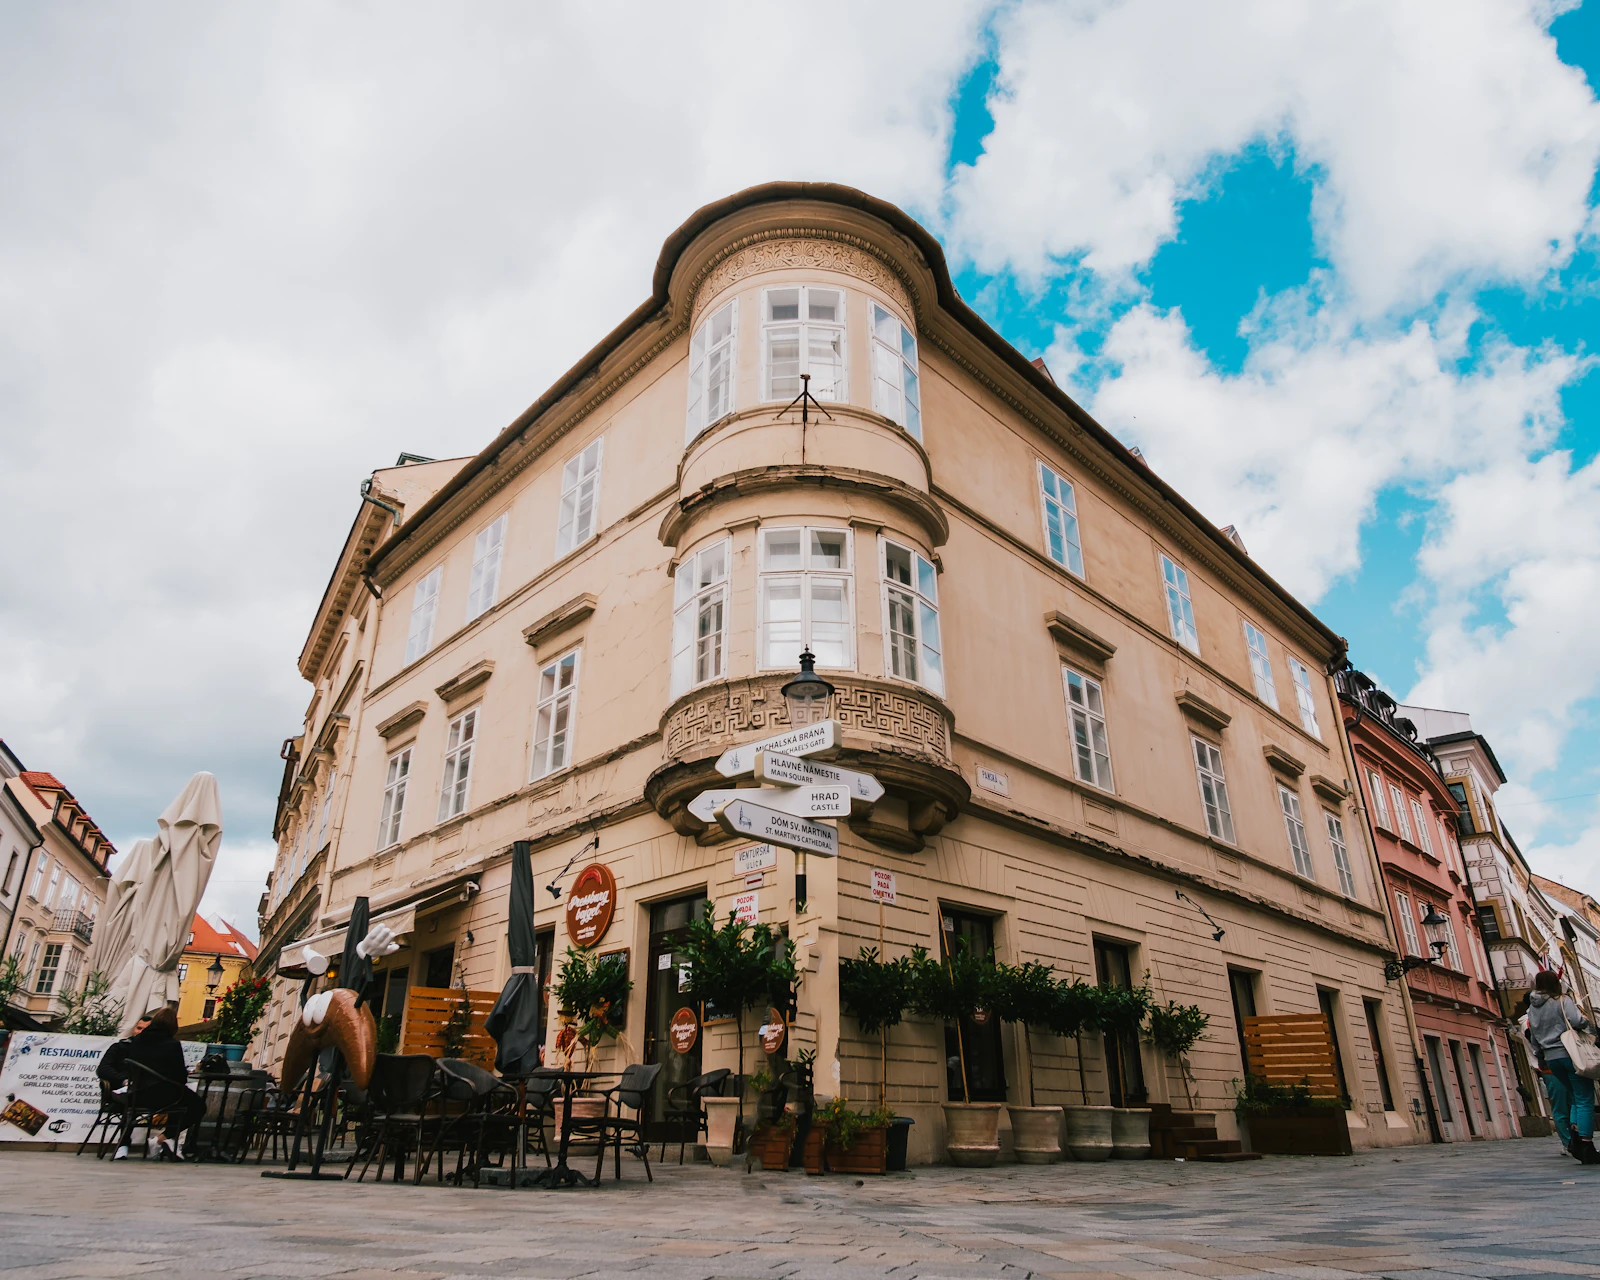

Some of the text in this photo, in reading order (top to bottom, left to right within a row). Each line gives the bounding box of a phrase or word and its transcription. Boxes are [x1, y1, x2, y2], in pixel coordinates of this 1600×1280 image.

[755, 727, 825, 753] MICHALSKÁ BRÁNA
[809, 738, 825, 748] GATE
[771, 757, 841, 781] HLAVNÉ NÁMESTIE
[770, 768, 813, 784] MAIN SQUARE
[811, 792, 840, 801] HRAD
[811, 803, 840, 811] CASTLE
[771, 816, 832, 840] DÓM SV. MARTINA
[765, 826, 833, 850] ST. MARTIN'S CATHEDRAL
[746, 859, 763, 870] ULICA
[39, 1047, 102, 1059] RESTAURANT
[37, 1062, 51, 1070] WE
[51, 1062, 76, 1071] OFFER
